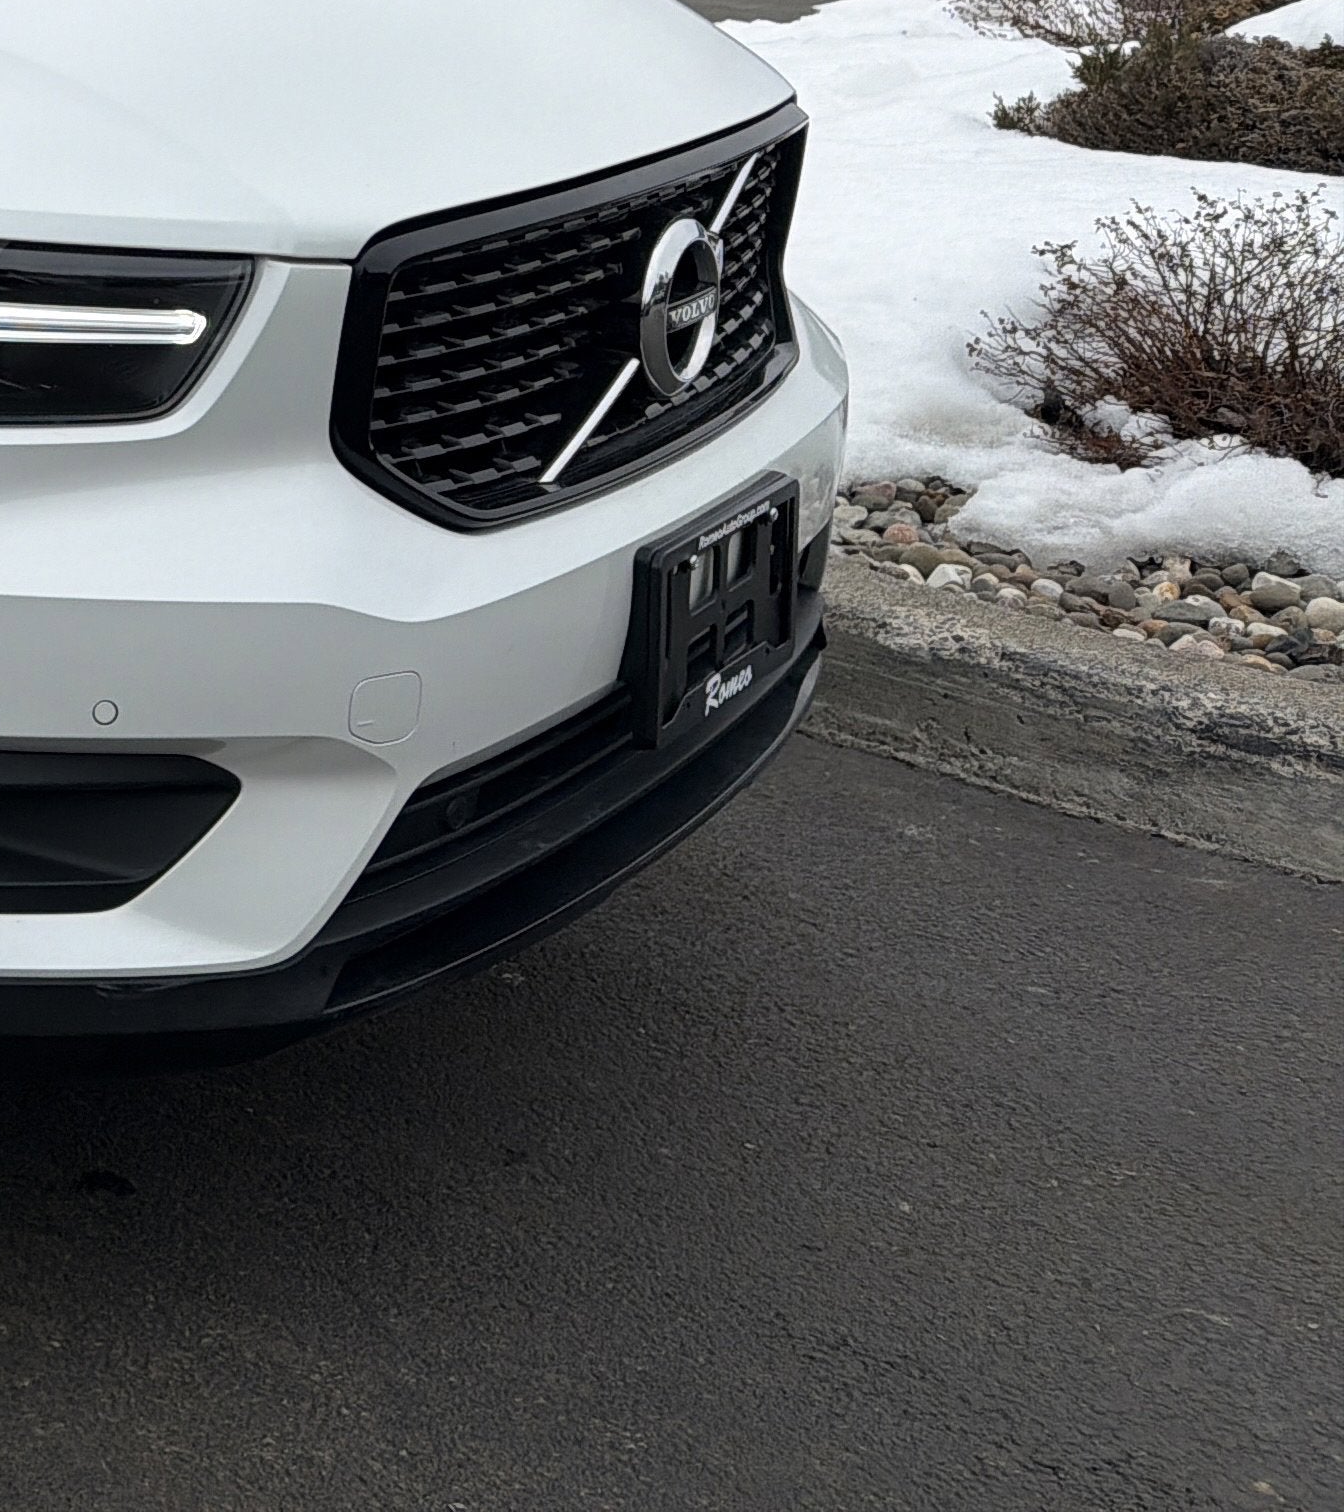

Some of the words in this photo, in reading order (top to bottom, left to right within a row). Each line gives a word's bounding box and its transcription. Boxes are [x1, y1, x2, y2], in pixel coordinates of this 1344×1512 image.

[668, 293, 715, 324] VOLVO
[698, 500, 770, 551] RomeoAutoGroup.com
[704, 664, 753, 717] Romeo
